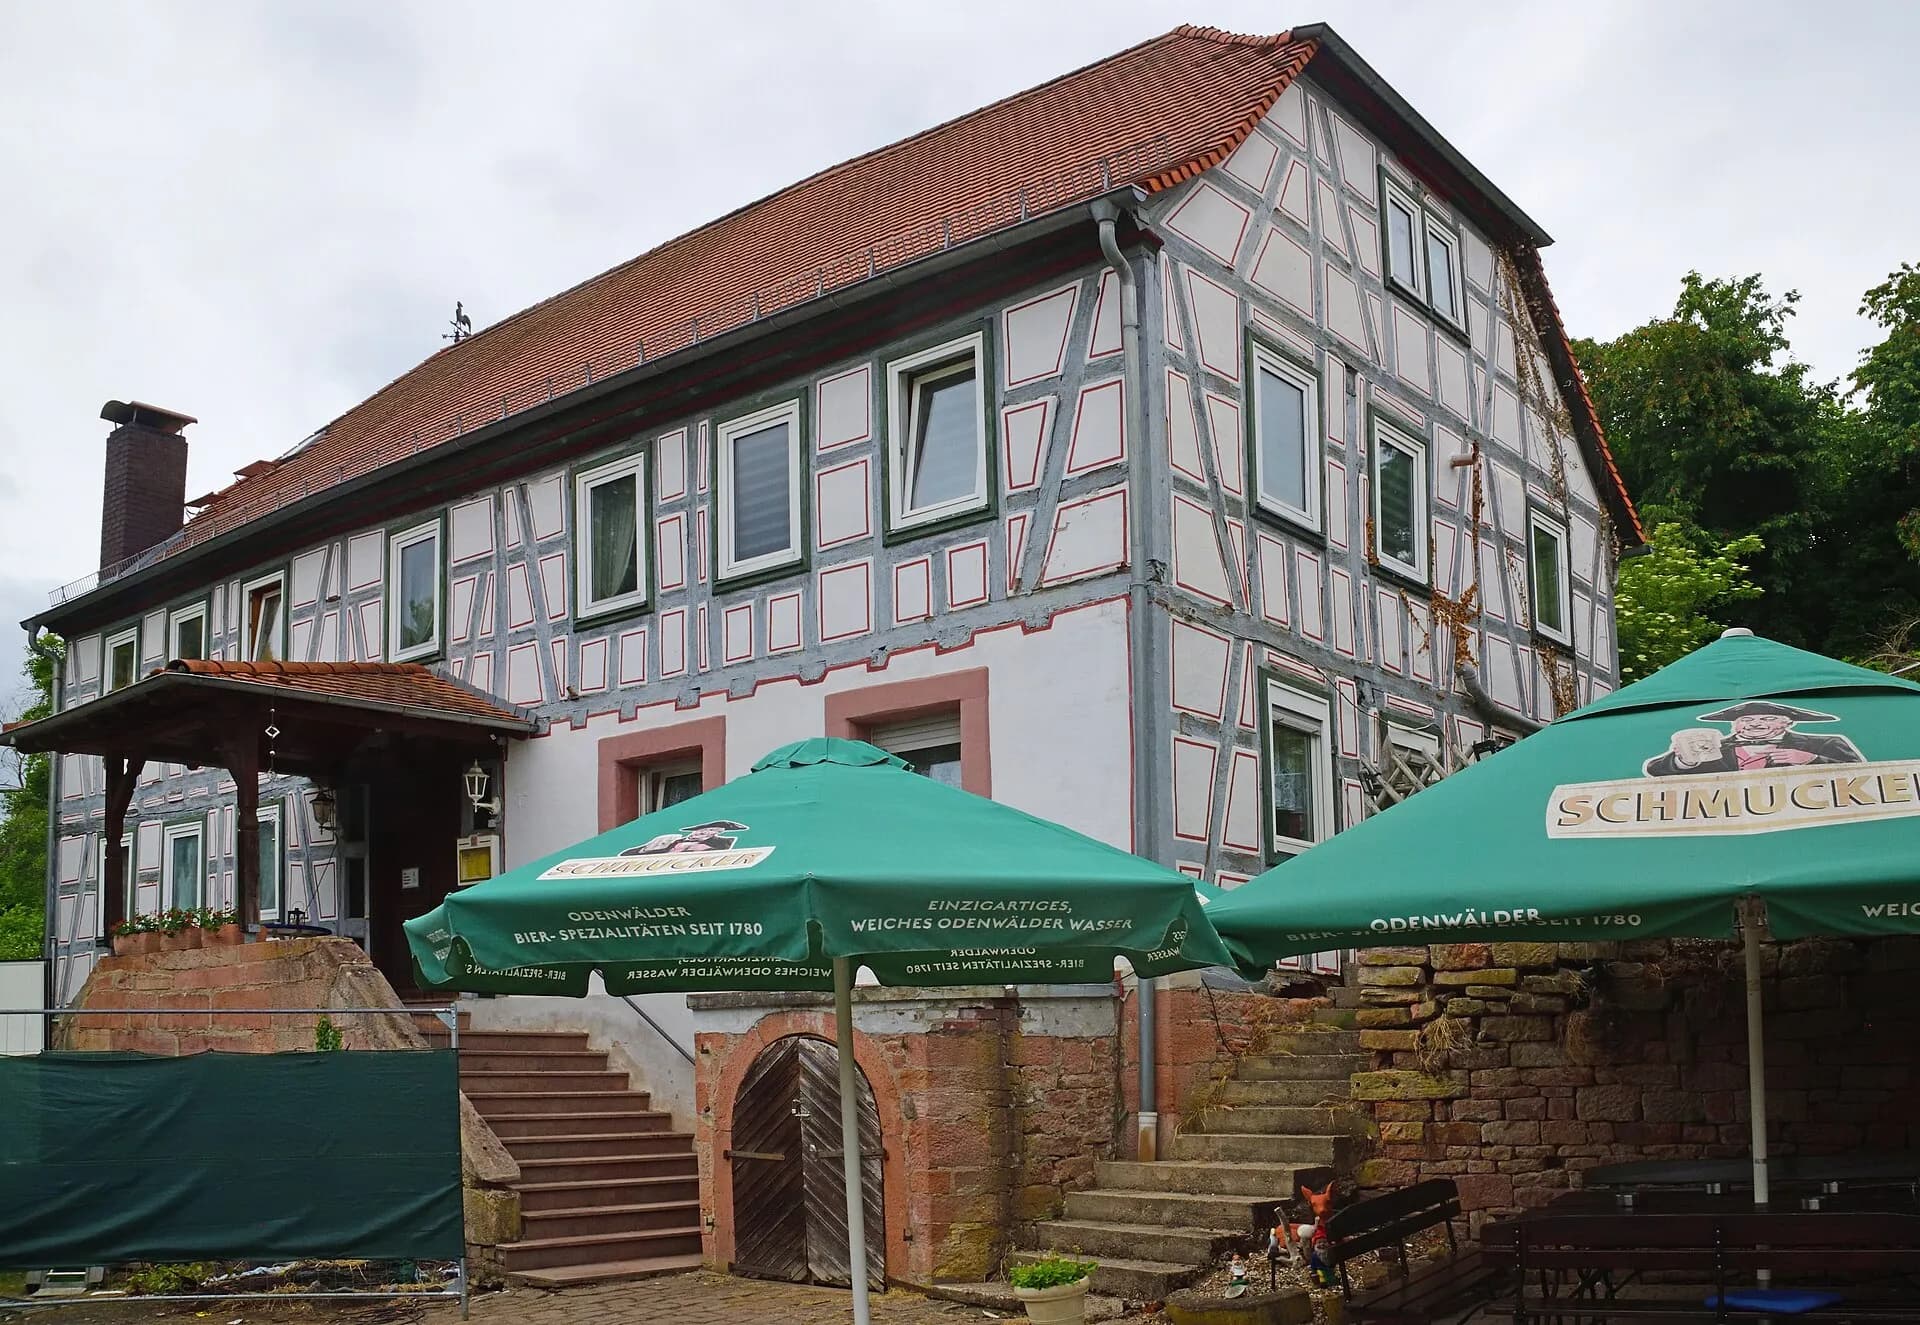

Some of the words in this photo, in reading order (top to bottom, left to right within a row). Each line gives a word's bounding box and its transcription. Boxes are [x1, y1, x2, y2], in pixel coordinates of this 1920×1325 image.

[1557, 773, 1920, 827] SCHMUCKE
[547, 851, 762, 876] SCHMUCKER
[567, 906, 692, 922] ODENWÄLDER
[927, 900, 1073, 914] EINZIGARTIGES,
[851, 917, 932, 932] WEICHES
[938, 915, 1064, 930] ODENWÄLDER
[1069, 918, 1133, 931] WASSER
[1370, 908, 1541, 931] ODENWÄLDER
[1594, 914, 1642, 926] 1780
[513, 930, 556, 944] BIER-
[559, 923, 686, 941] SPEZIALITÄTEN
[689, 922, 725, 936] SEIT
[730, 922, 763, 936] 1780
